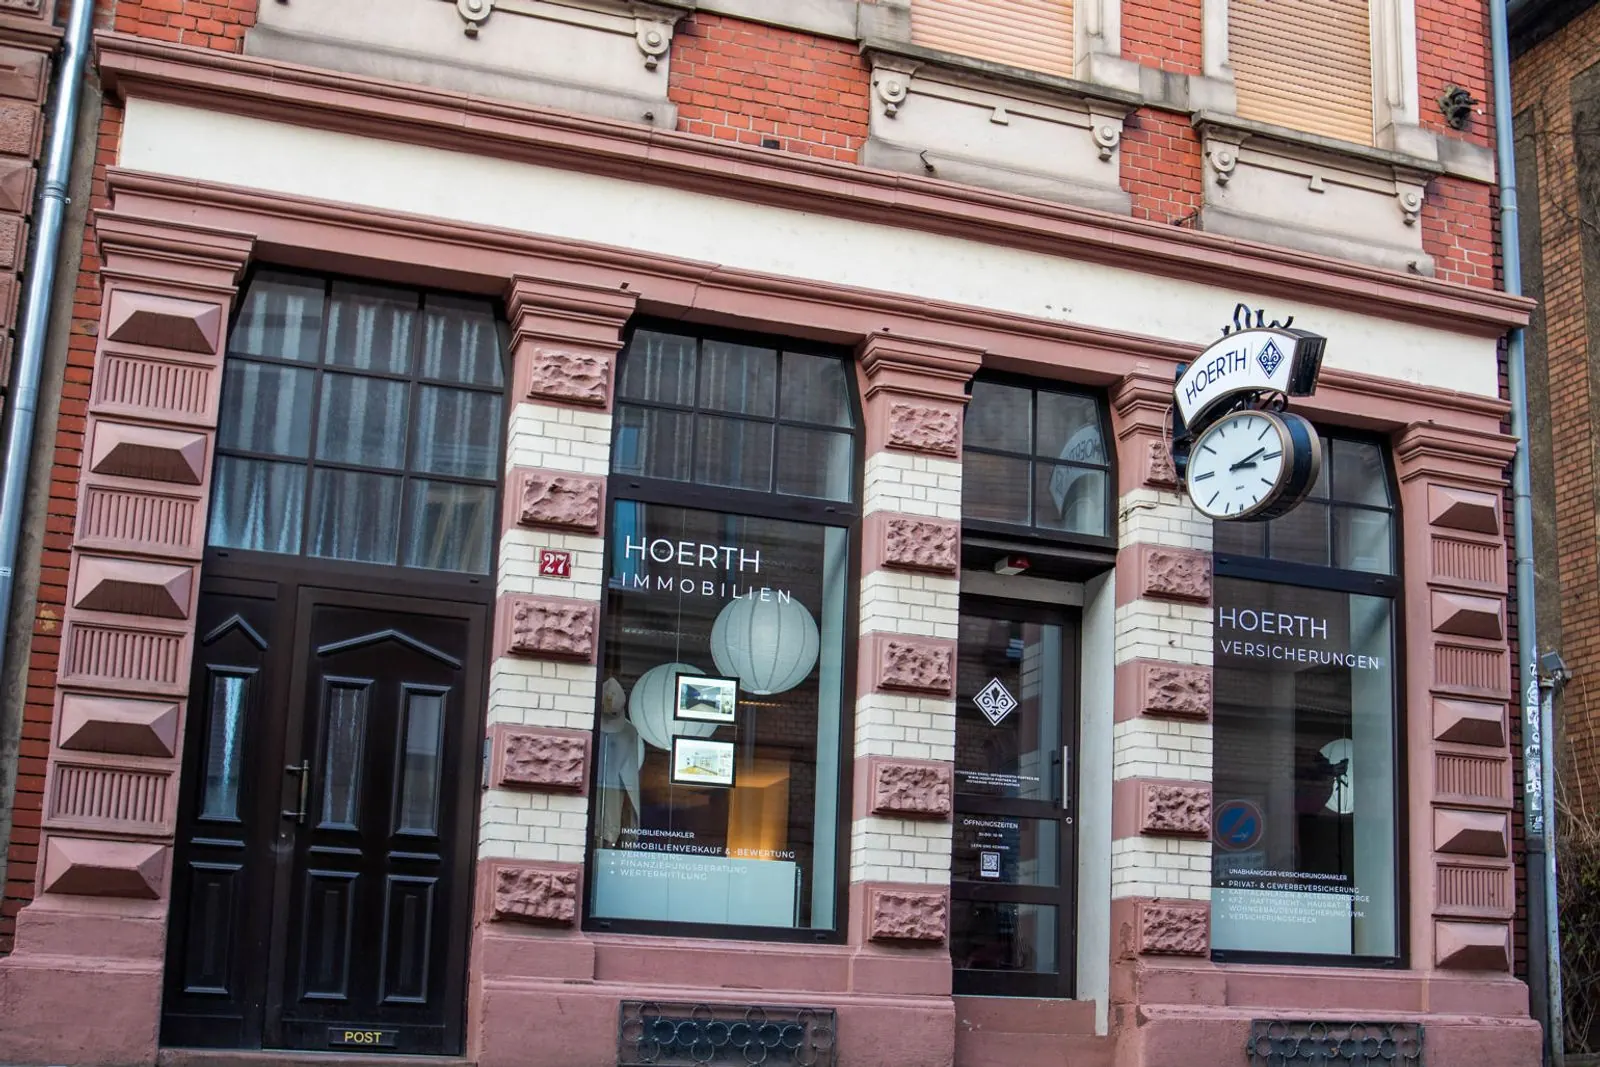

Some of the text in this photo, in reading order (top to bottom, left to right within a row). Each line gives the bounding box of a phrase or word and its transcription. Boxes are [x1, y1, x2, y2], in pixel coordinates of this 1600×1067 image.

[1185, 347, 1247, 406] HOERTH
[543, 552, 568, 575] 27
[624, 535, 760, 574] HOERTH
[621, 571, 791, 605] IMMOBILIEN
[1218, 606, 1328, 640] HOERTH
[1220, 639, 1380, 670] VERSICHERUNGEN
[621, 827, 695, 839] IMMOBILIENMAKLER
[621, 841, 796, 859] IMMOBILIENVERKAUF & -BEWERTUNG
[620, 869, 708, 881] WERTERMITTLUNG
[1228, 880, 1258, 889] PRIVAT-
[1266, 882, 1360, 894] GEWERBEVERSICHERUNG
[344, 1031, 382, 1043] POST
